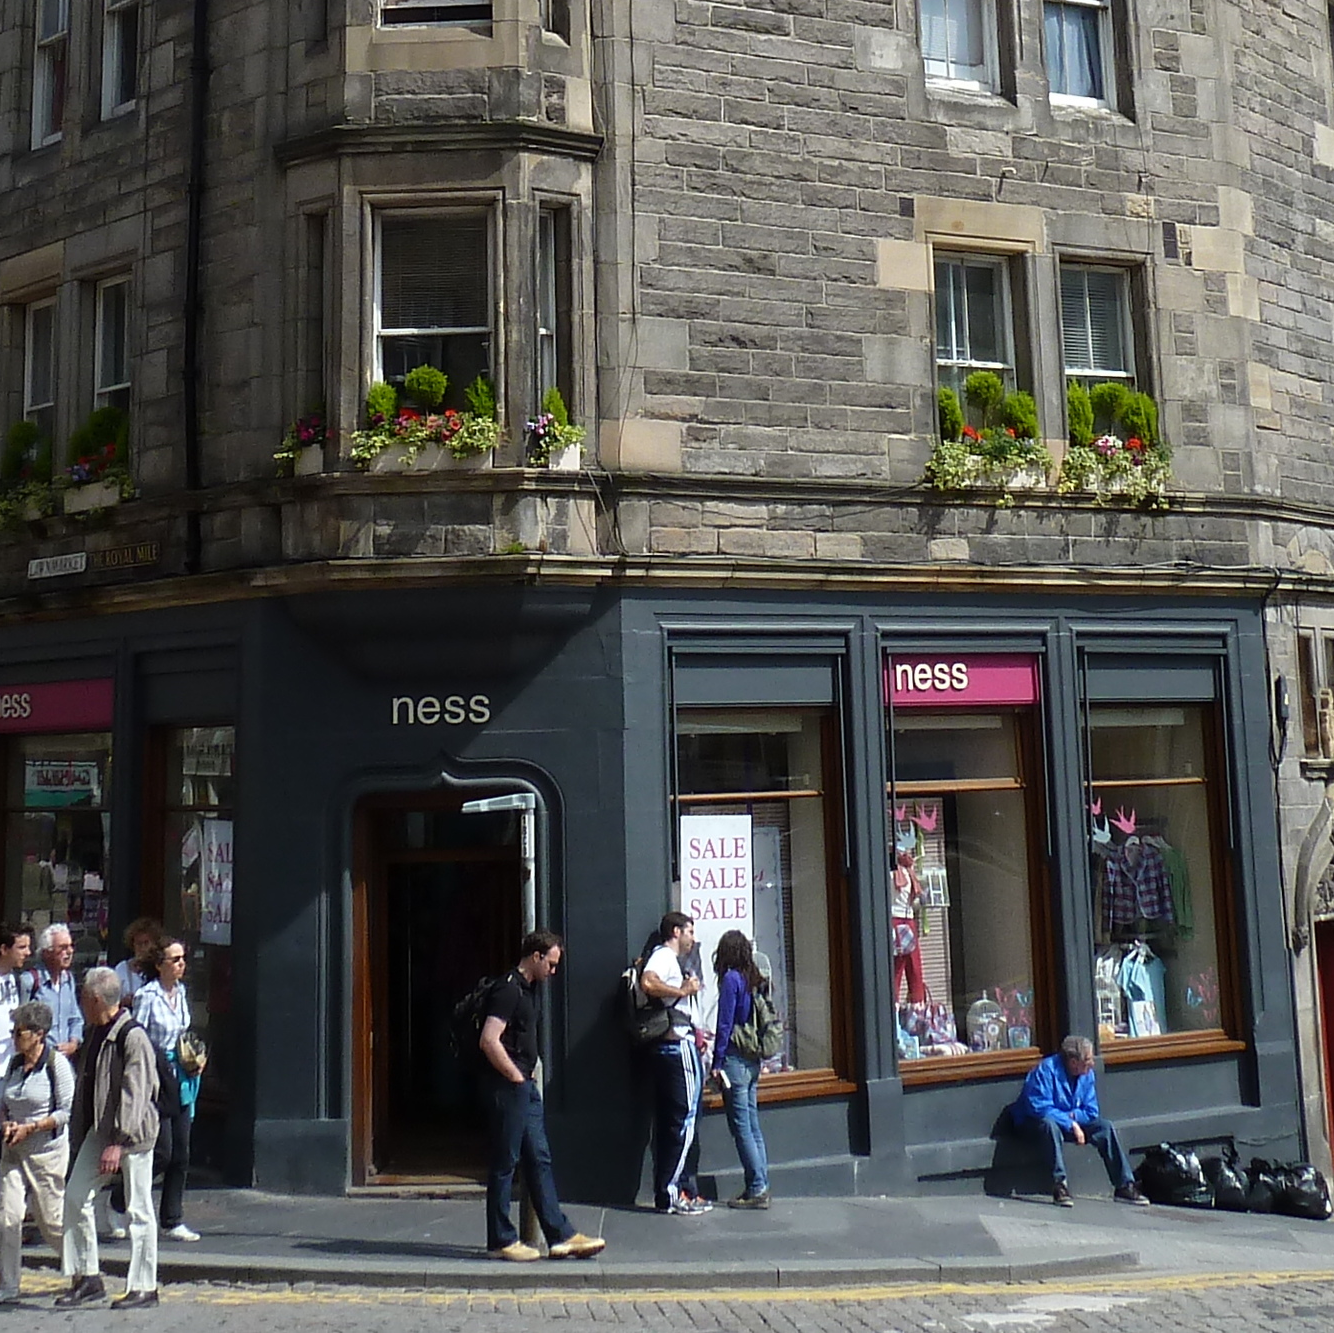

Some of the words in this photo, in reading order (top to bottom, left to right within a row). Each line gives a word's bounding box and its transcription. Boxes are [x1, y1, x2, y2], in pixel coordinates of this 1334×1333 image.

[106, 549, 134, 567] ROYAL
[136, 544, 158, 563] MILE
[895, 661, 969, 692] ness
[391, 693, 491, 726] ness
[207, 841, 233, 863] SAL
[689, 837, 747, 860] SALE
[689, 867, 747, 890] SALE
[206, 901, 231, 923] SAL
[689, 897, 748, 920] SALE
